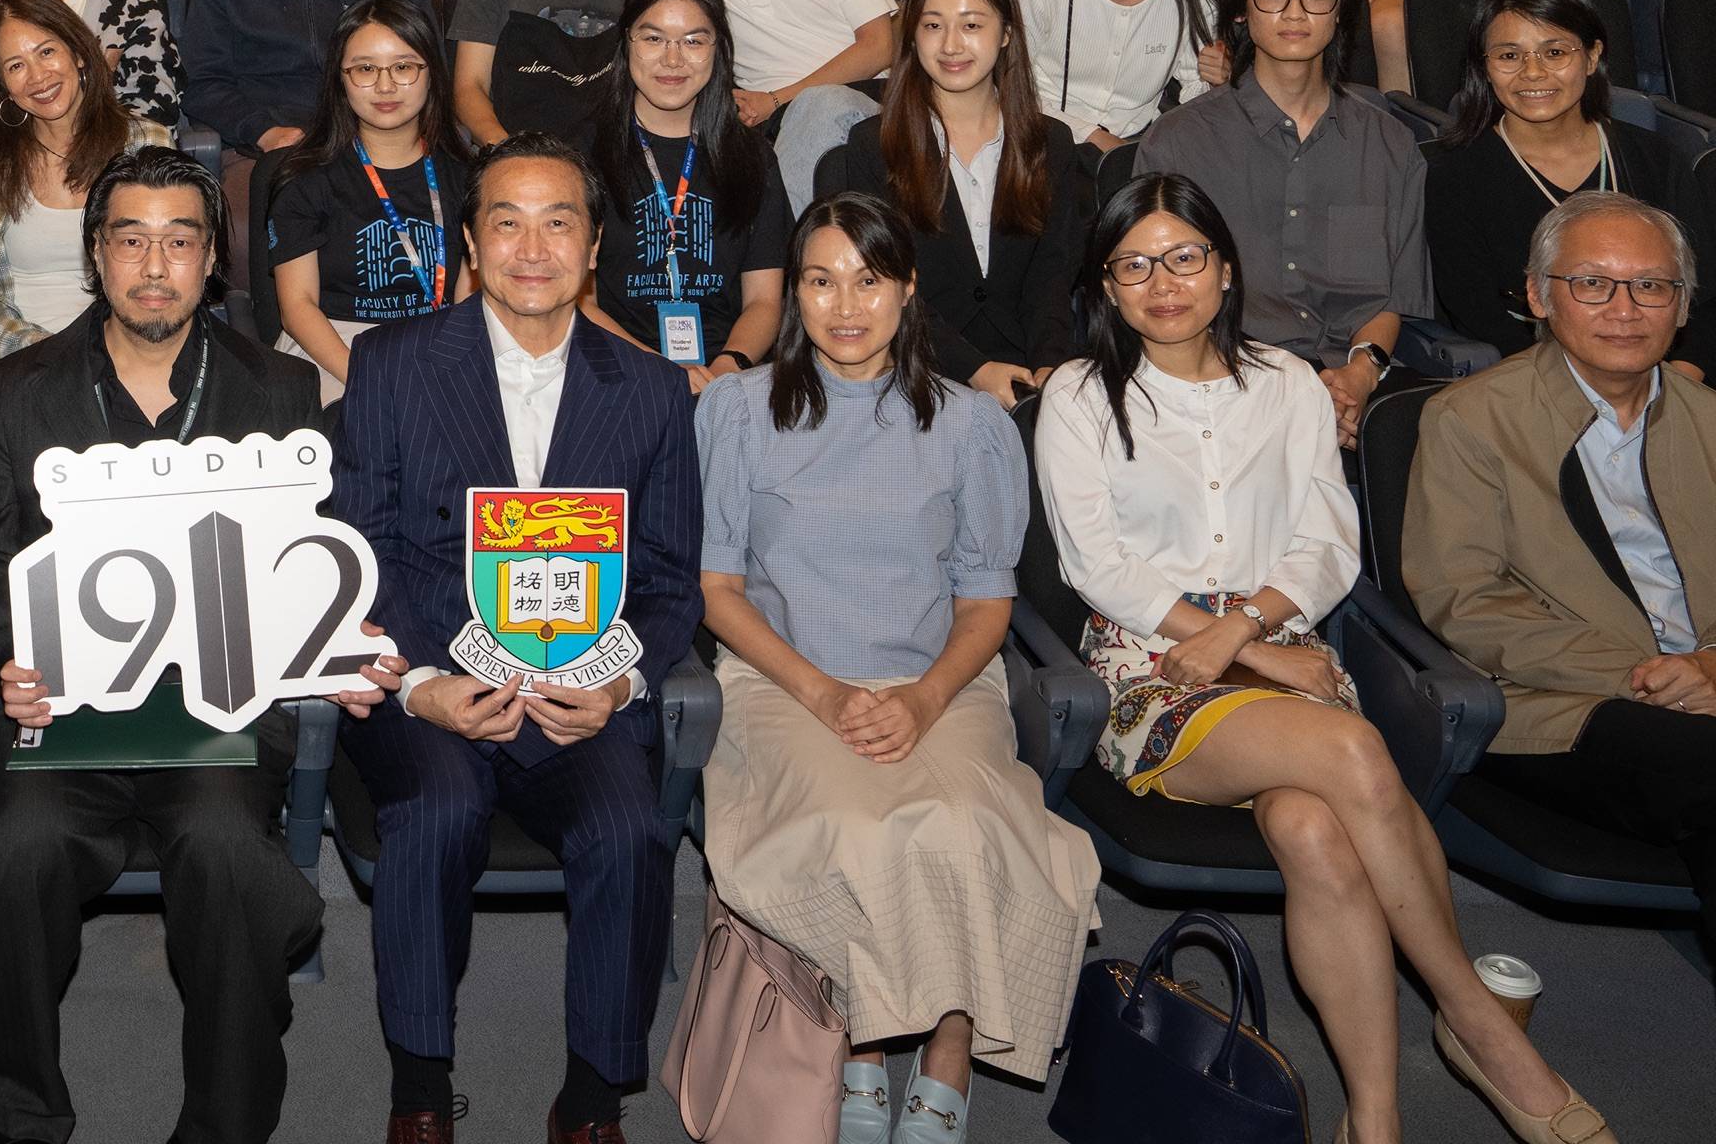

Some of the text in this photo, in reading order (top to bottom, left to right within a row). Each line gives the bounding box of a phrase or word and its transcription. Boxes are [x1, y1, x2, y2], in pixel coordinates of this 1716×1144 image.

[627, 273, 670, 287] FACULTY
[695, 274, 724, 287] ARTS
[355, 296, 399, 309] FACULTY
[405, 293, 418, 306] OF
[627, 289, 639, 297] THE
[355, 310, 367, 318] THE
[369, 310, 406, 318] UNIVERSITY
[50, 445, 318, 484] STUDIO
[26, 510, 382, 715] 1912
[461, 642, 535, 687] SAPIENIA
[572, 644, 631, 685] VIRTUS
